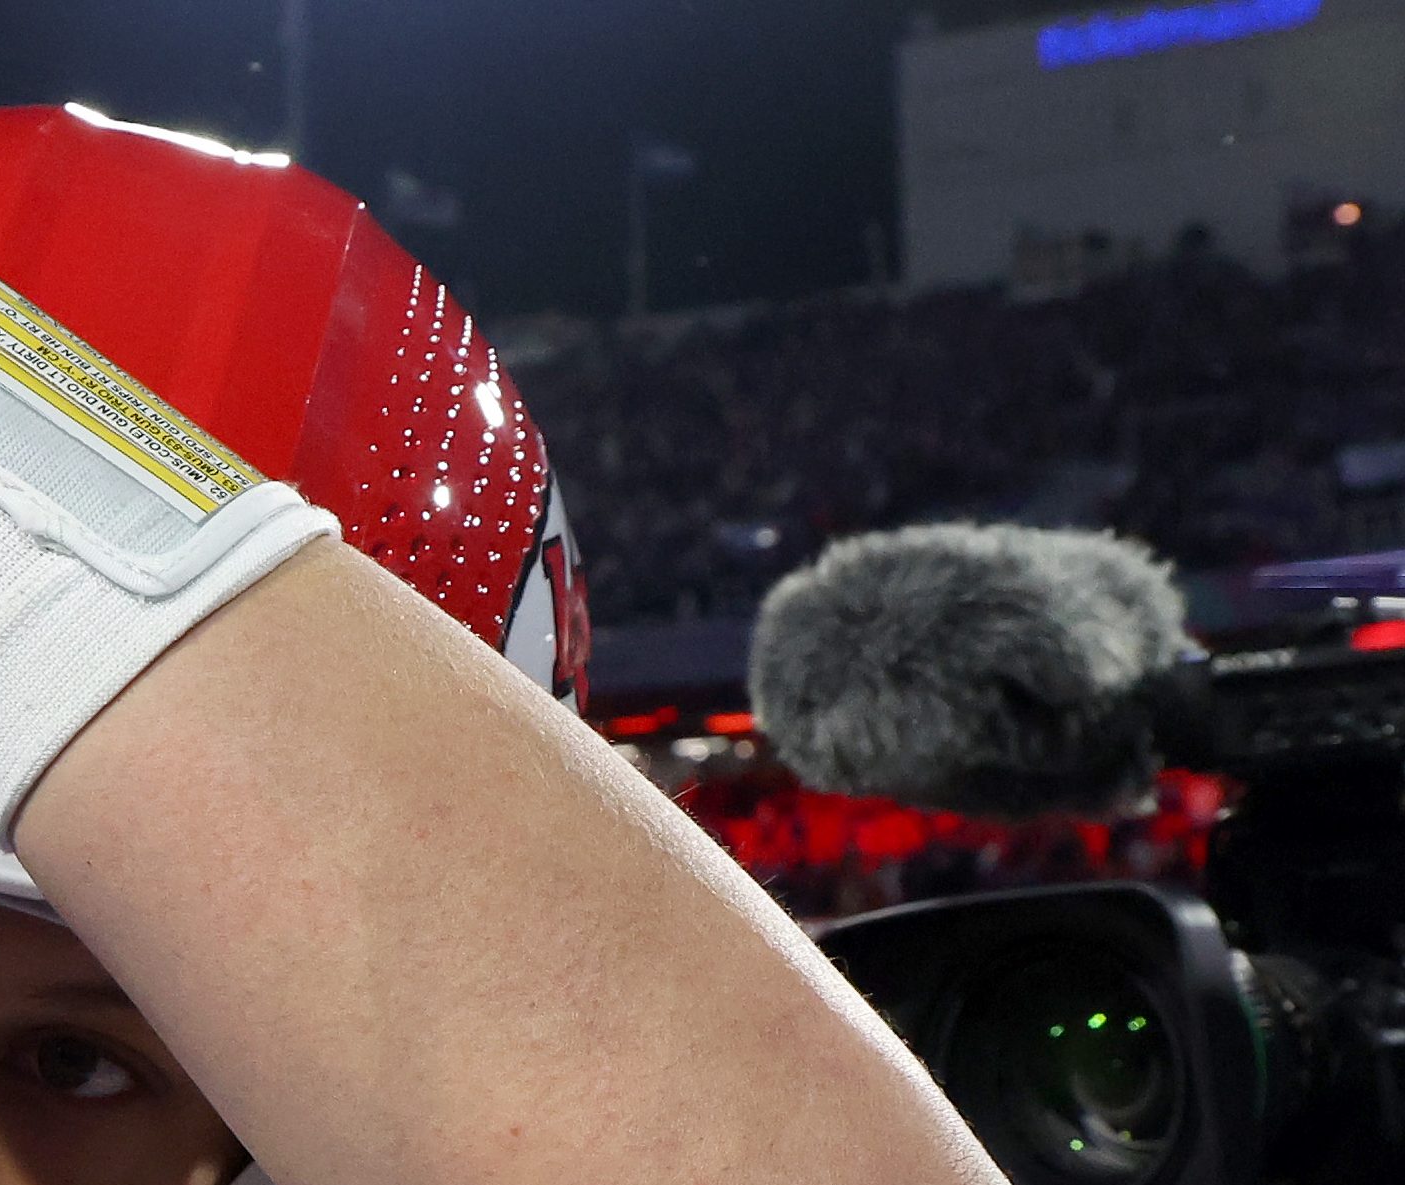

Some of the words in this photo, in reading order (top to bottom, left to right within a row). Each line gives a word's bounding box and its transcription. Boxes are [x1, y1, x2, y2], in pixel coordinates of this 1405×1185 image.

[20, 320, 40, 333] RT
[6, 340, 49, 370] DIRTY
[36, 345, 59, 361] CM
[60, 349, 90, 369] BUN
[77, 375, 98, 389] RT
[90, 370, 110, 383] RT
[65, 383, 98, 405] DUO
[97, 389, 129, 411] TRIO
[110, 385, 148, 411] TRIPS
[97, 405, 128, 427] GUN
[130, 413, 161, 434] GUN
[149, 413, 180, 434] GUN
[127, 425, 208, 483] (MUS-COLE)
